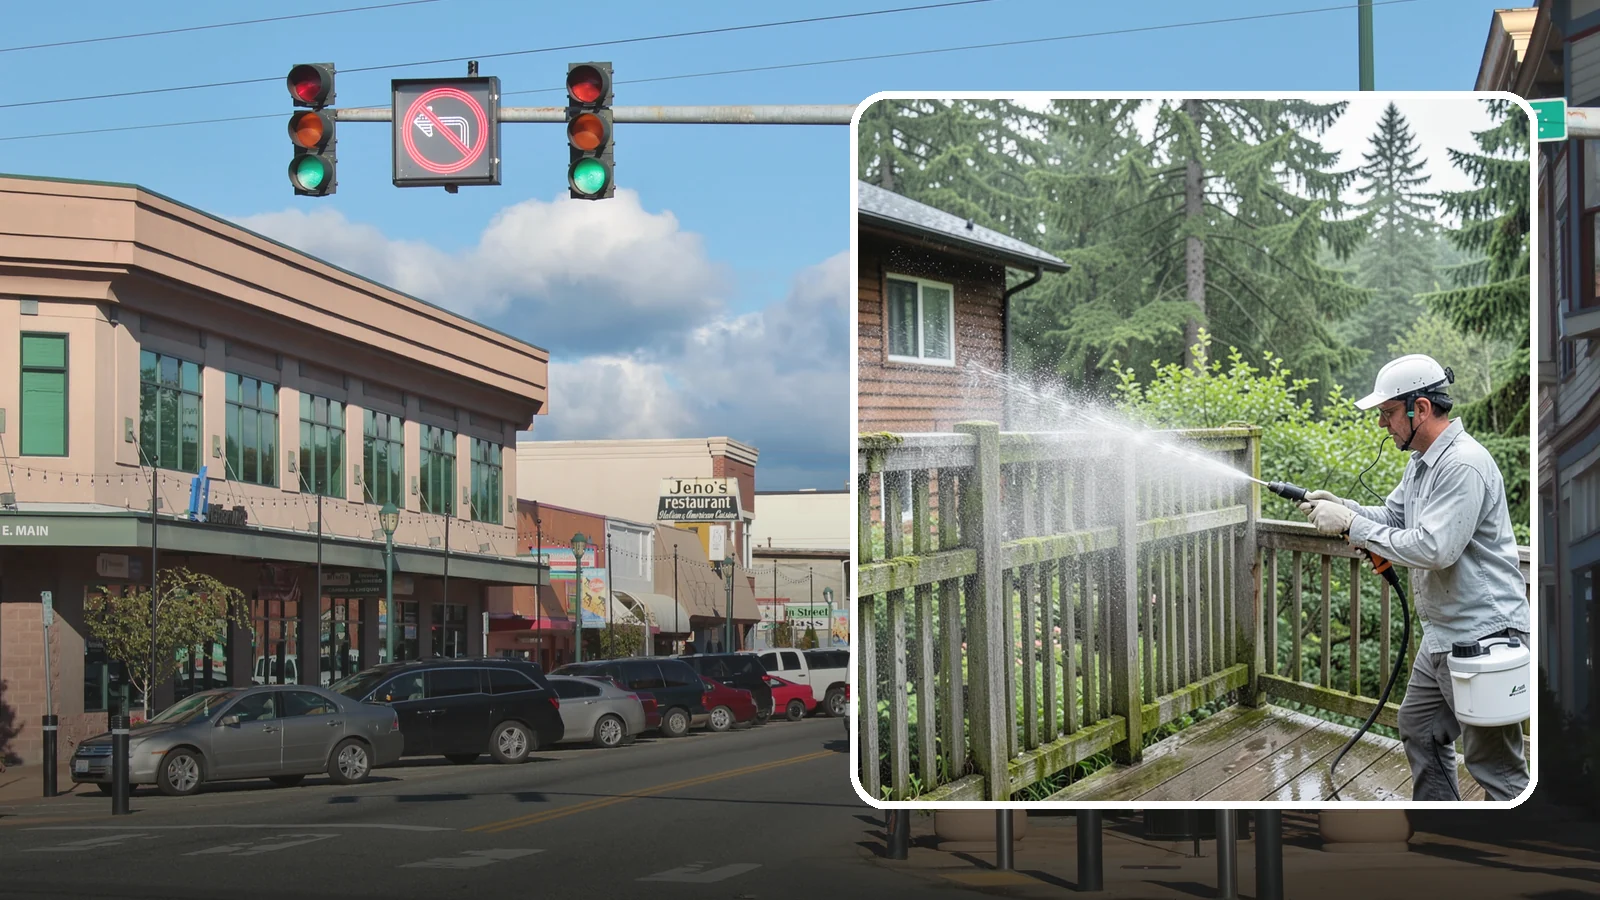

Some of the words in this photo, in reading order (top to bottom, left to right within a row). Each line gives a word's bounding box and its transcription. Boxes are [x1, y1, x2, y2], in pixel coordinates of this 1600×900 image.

[670, 480, 727, 494] Jeno's
[665, 496, 731, 509] restaurant
[686, 509, 714, 519] American
[715, 509, 738, 519] Cuisine
[2, 525, 13, 536] E.
[15, 525, 49, 536] MAIN
[797, 608, 829, 617] Street
[791, 619, 824, 628] lass
